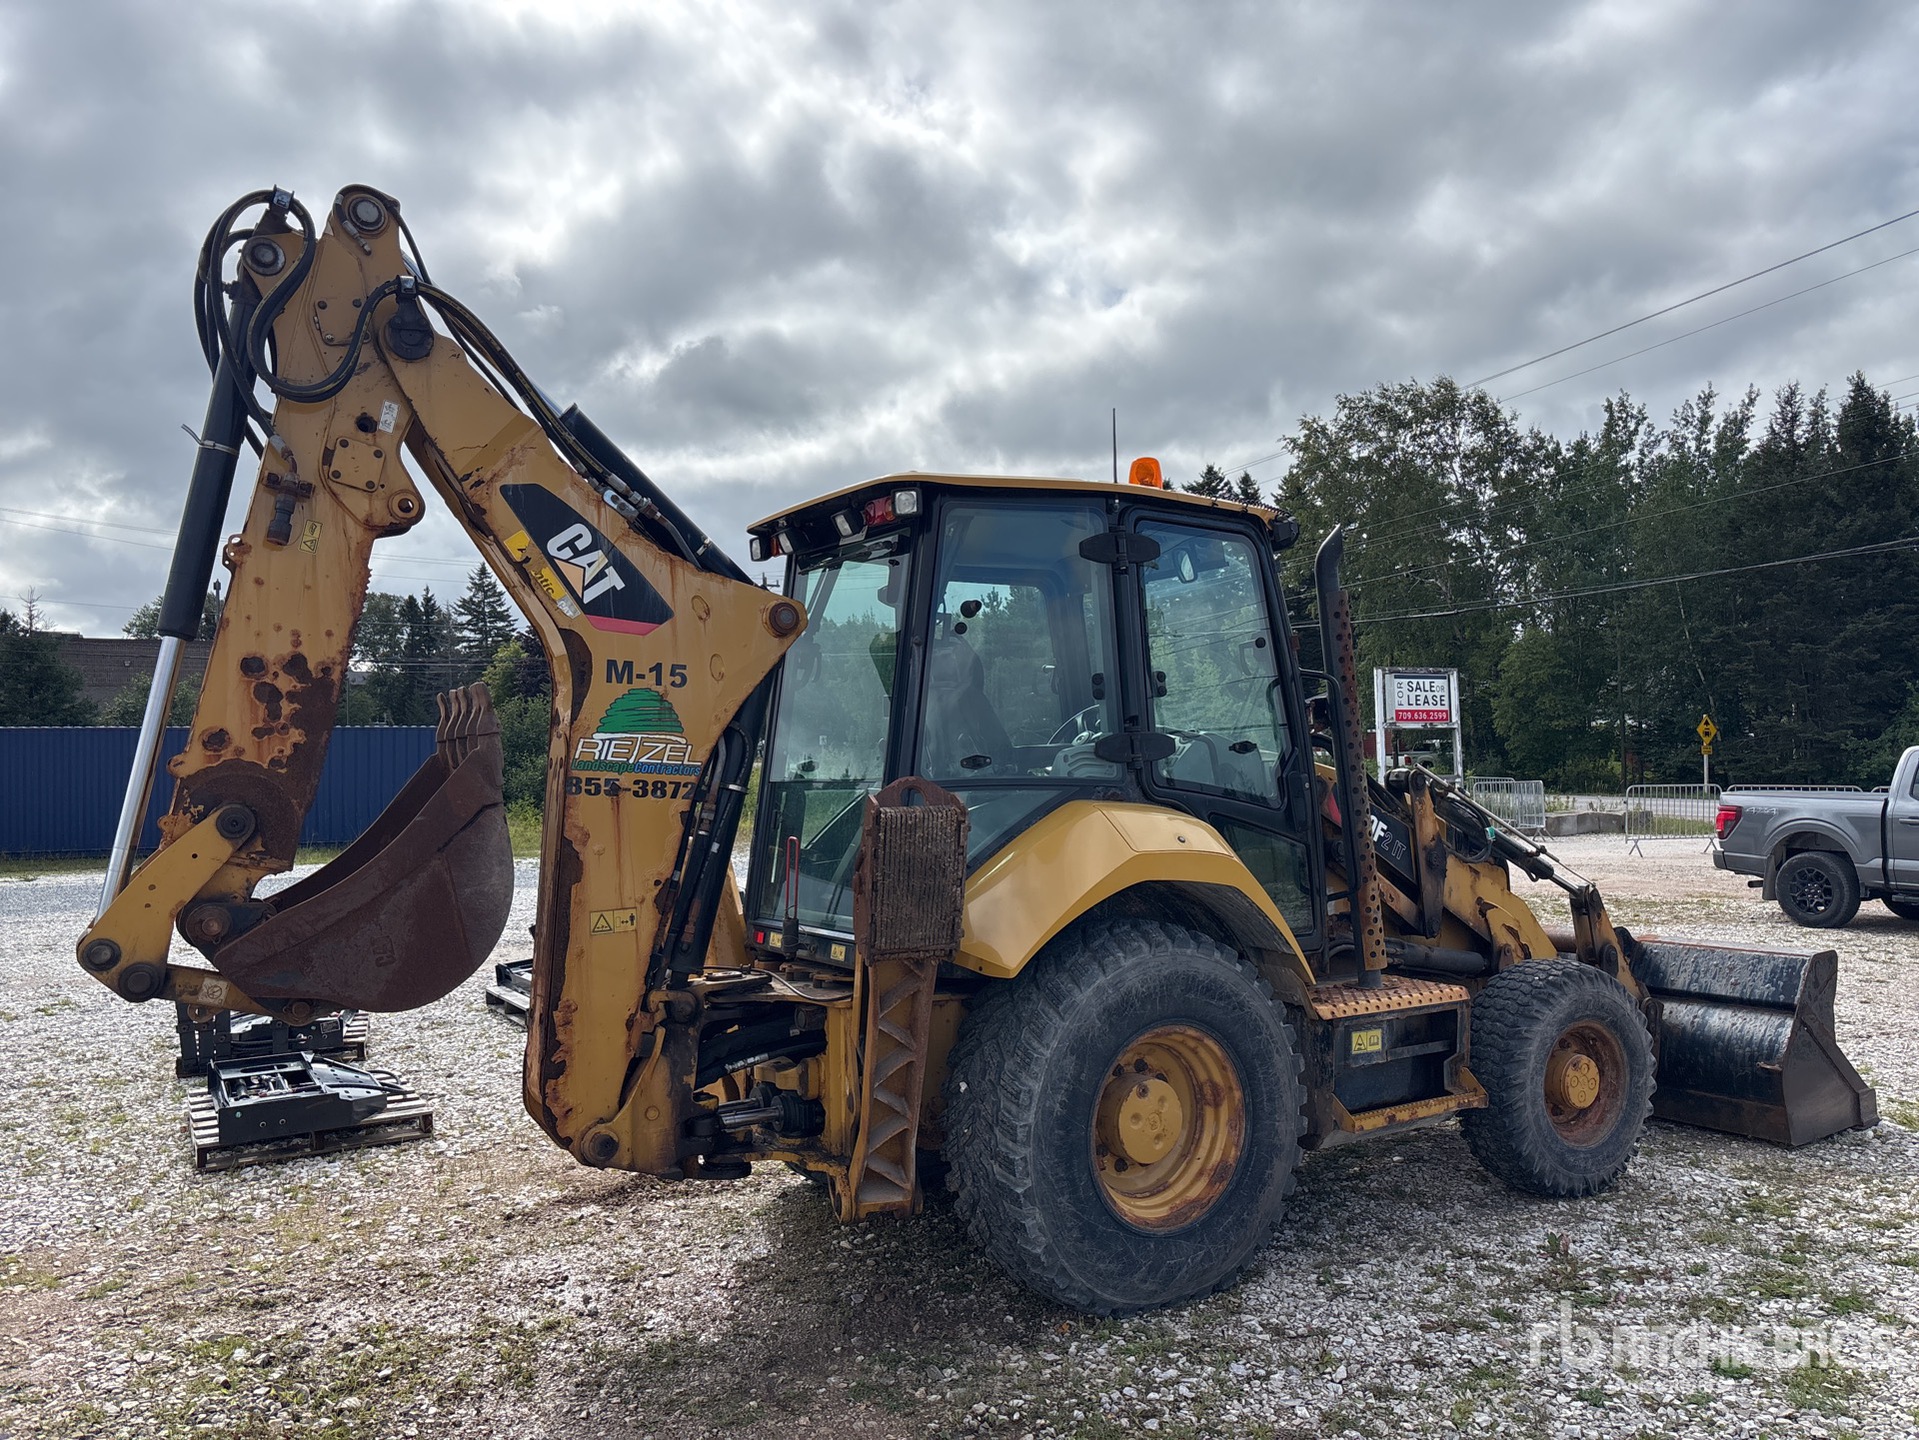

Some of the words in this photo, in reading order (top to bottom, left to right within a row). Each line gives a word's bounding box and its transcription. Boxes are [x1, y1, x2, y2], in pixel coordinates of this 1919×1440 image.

[547, 523, 626, 605] CAT
[606, 659, 687, 688] M-15
[1396, 681, 1404, 706] FOR
[1407, 680, 1436, 693] SALE
[1435, 685, 1446, 693] OR
[1407, 694, 1446, 707] LEASE
[1398, 711, 1447, 720] 709.636.2599
[574, 733, 702, 766] RIETZEL
[565, 776, 697, 800] 855-3872
